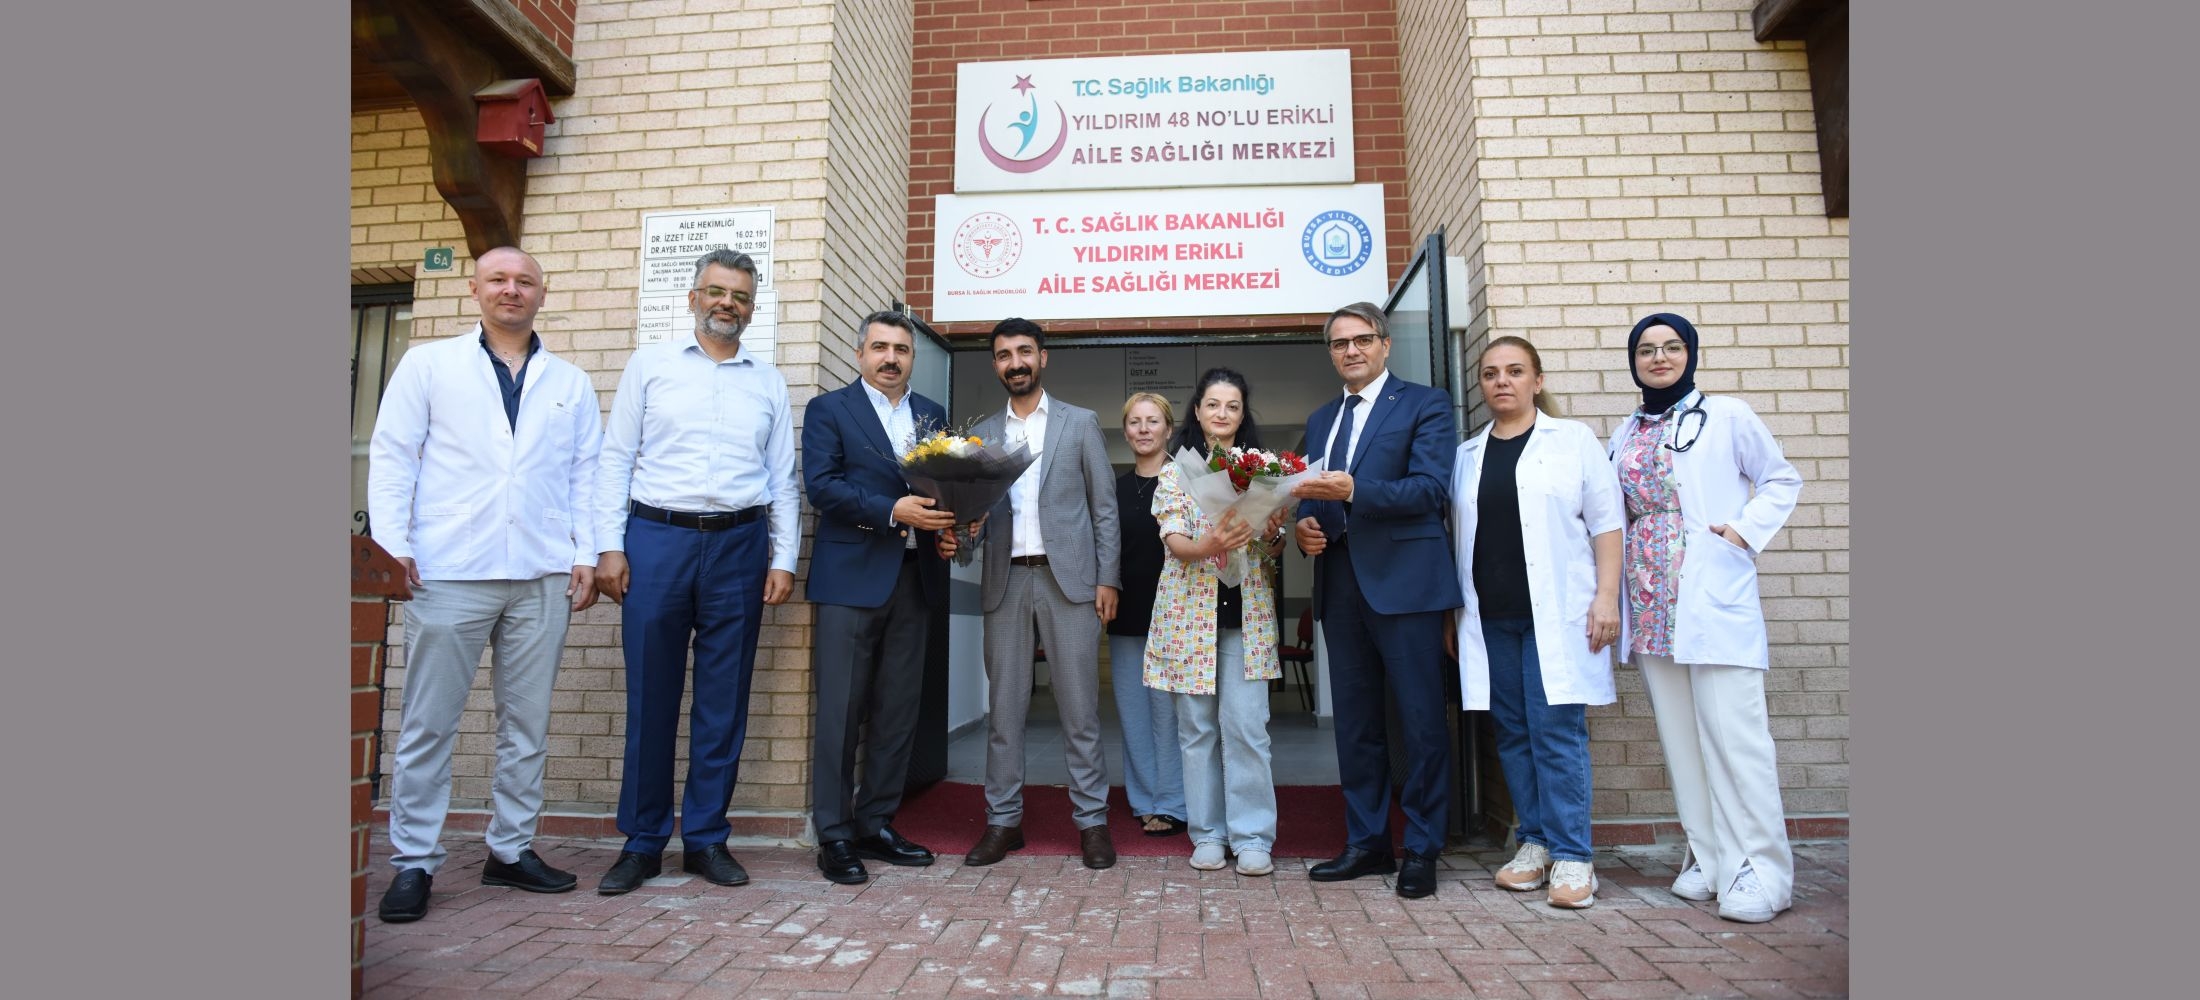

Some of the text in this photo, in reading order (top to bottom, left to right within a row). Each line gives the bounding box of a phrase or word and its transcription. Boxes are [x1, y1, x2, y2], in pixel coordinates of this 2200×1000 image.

[1072, 73, 1275, 99] T.C. Sağlık Bakanlığı
[1072, 113, 1161, 130] YILDIRIM
[1167, 112, 1190, 127] 48
[1267, 104, 1334, 125] ERİKLİ
[1072, 137, 1335, 164] AİLE SAĞLIĞI MERKEZİ
[1032, 207, 1284, 234] T. C. SAĞLIK BAKANLIĞI
[433, 252, 448, 267] 6A
[679, 244, 703, 253] TEZCAN
[1073, 244, 1168, 263] YILDIRIM
[973, 288, 992, 296] SAĞLIK
[1037, 267, 1280, 294] AİLE SAĞLIĞI MERKEZİ
